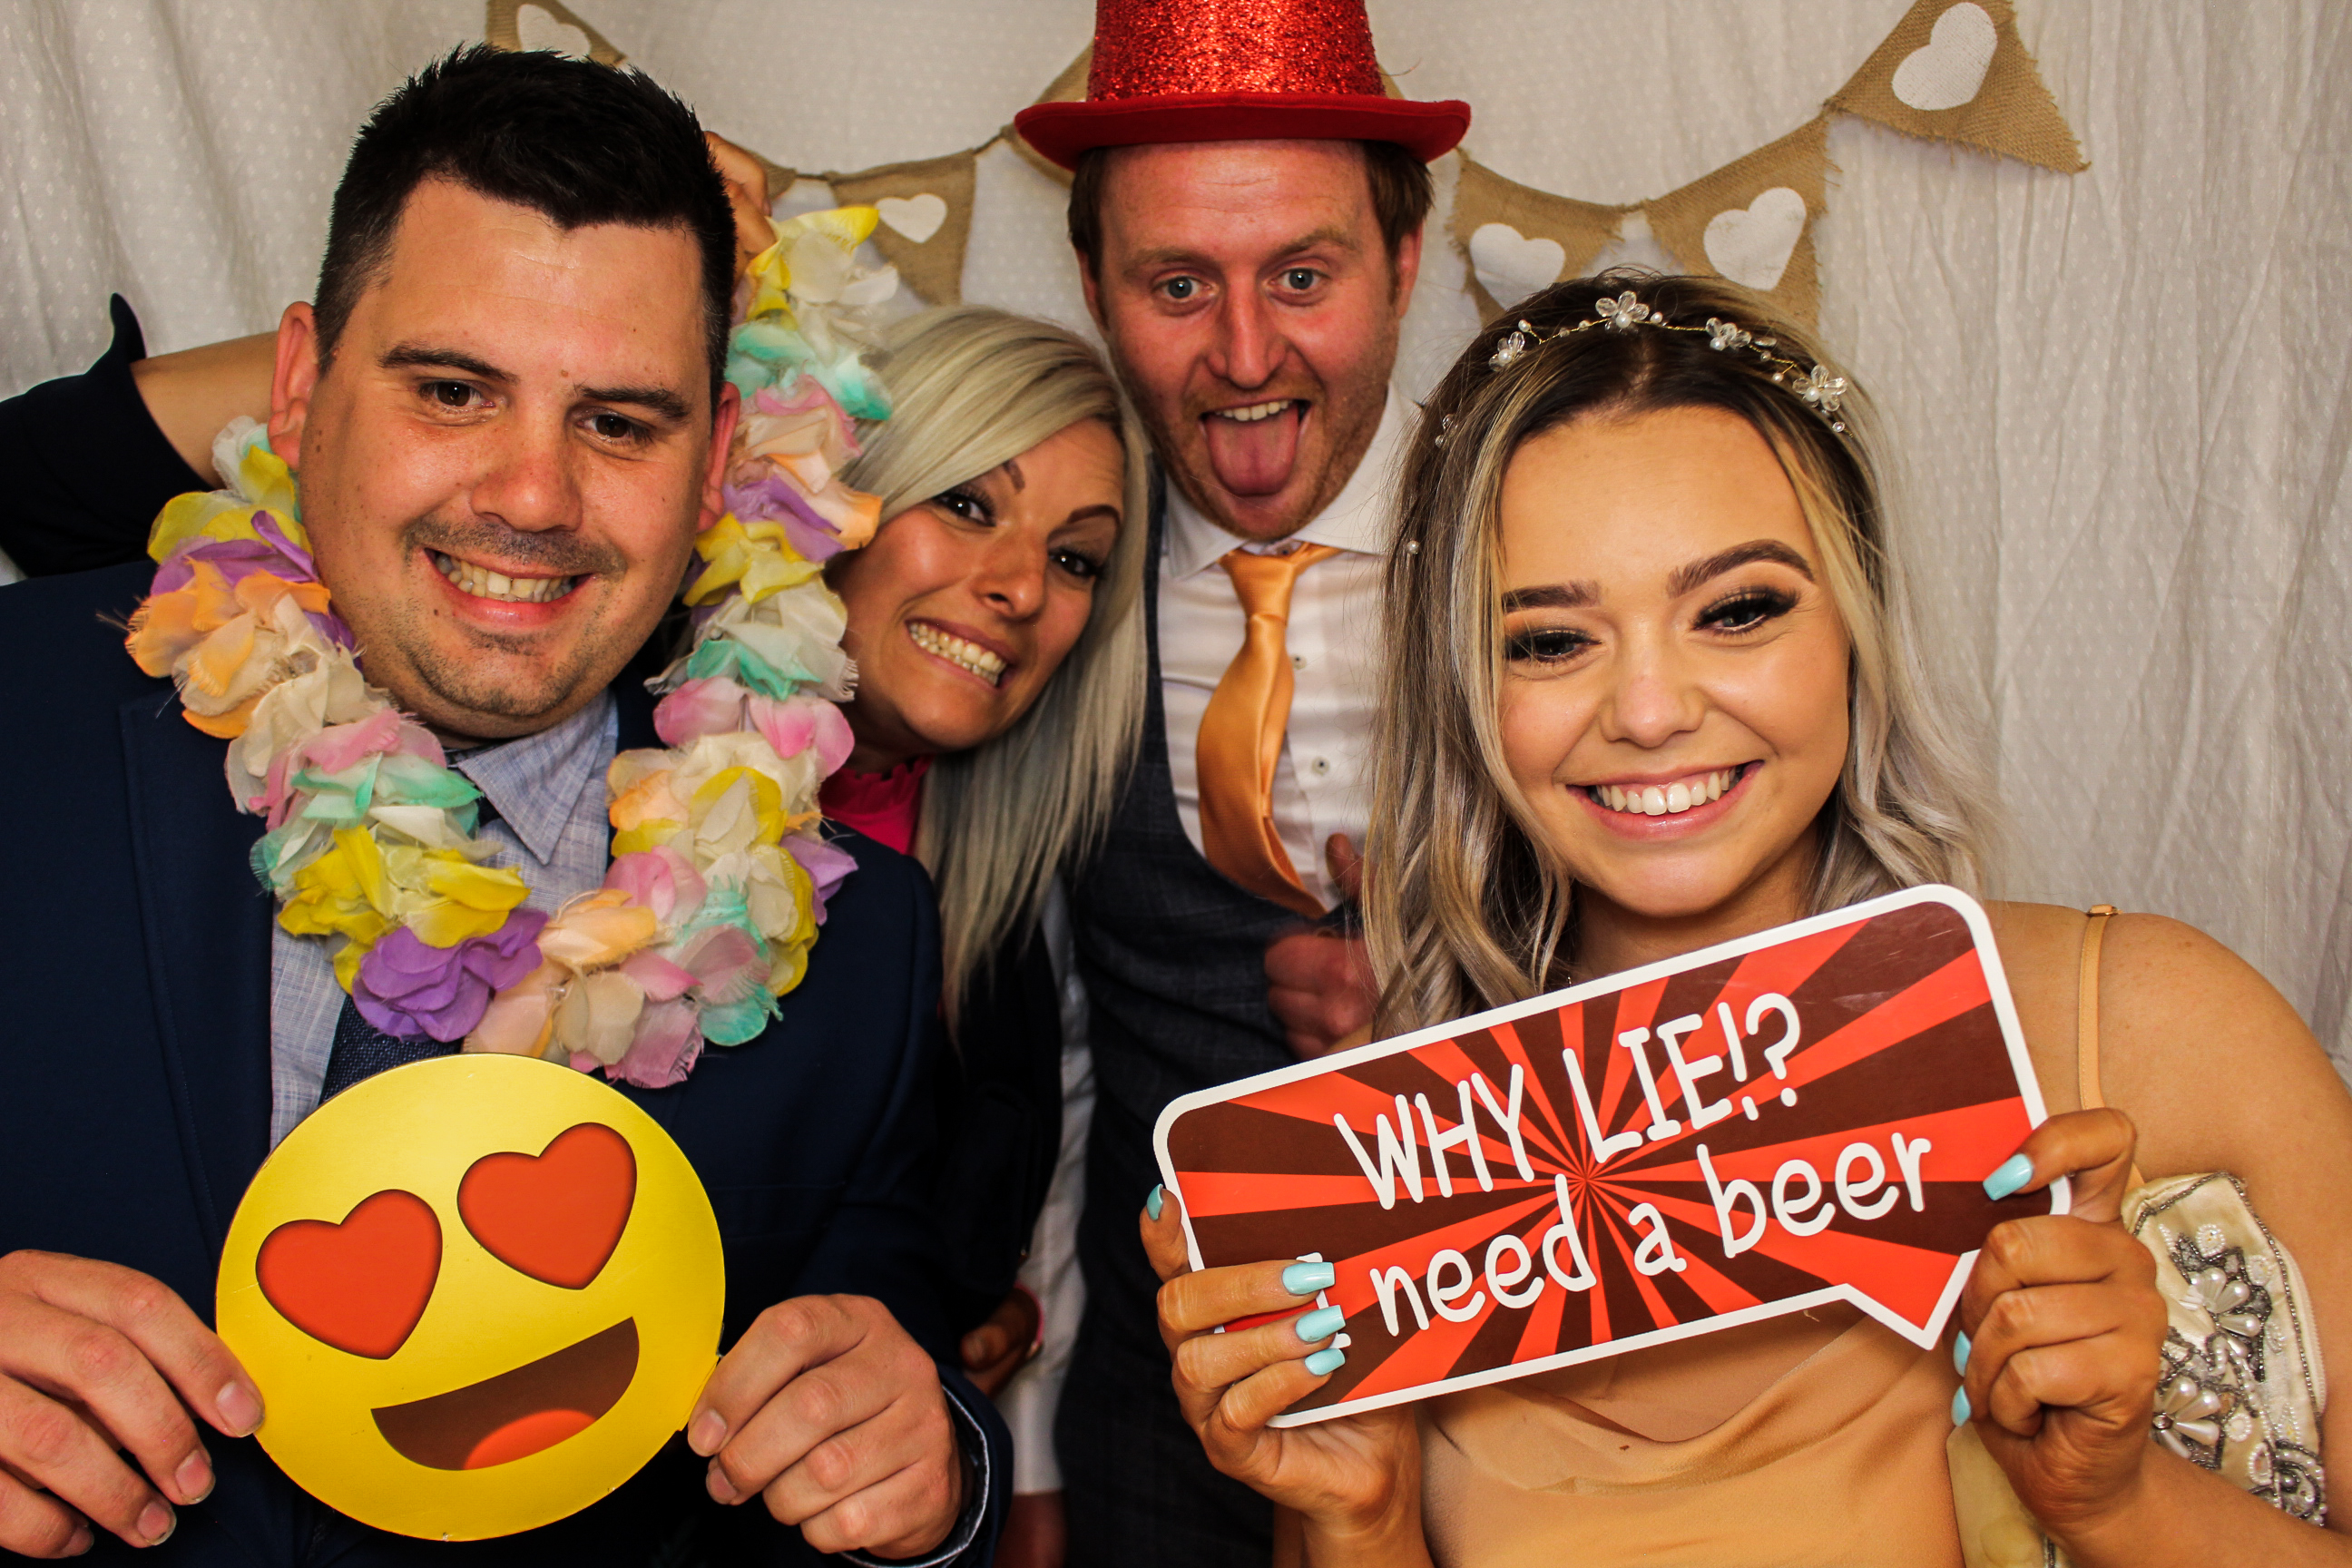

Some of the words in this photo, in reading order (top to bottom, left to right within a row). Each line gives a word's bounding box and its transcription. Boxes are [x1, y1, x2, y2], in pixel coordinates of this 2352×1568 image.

[1334, 1065, 1534, 1210] WHY
[1563, 993, 1800, 1163] LIE!?
[1370, 1174, 1597, 1337] need
[1629, 1203, 1687, 1276] a
[1697, 1132, 1931, 1259] beer
